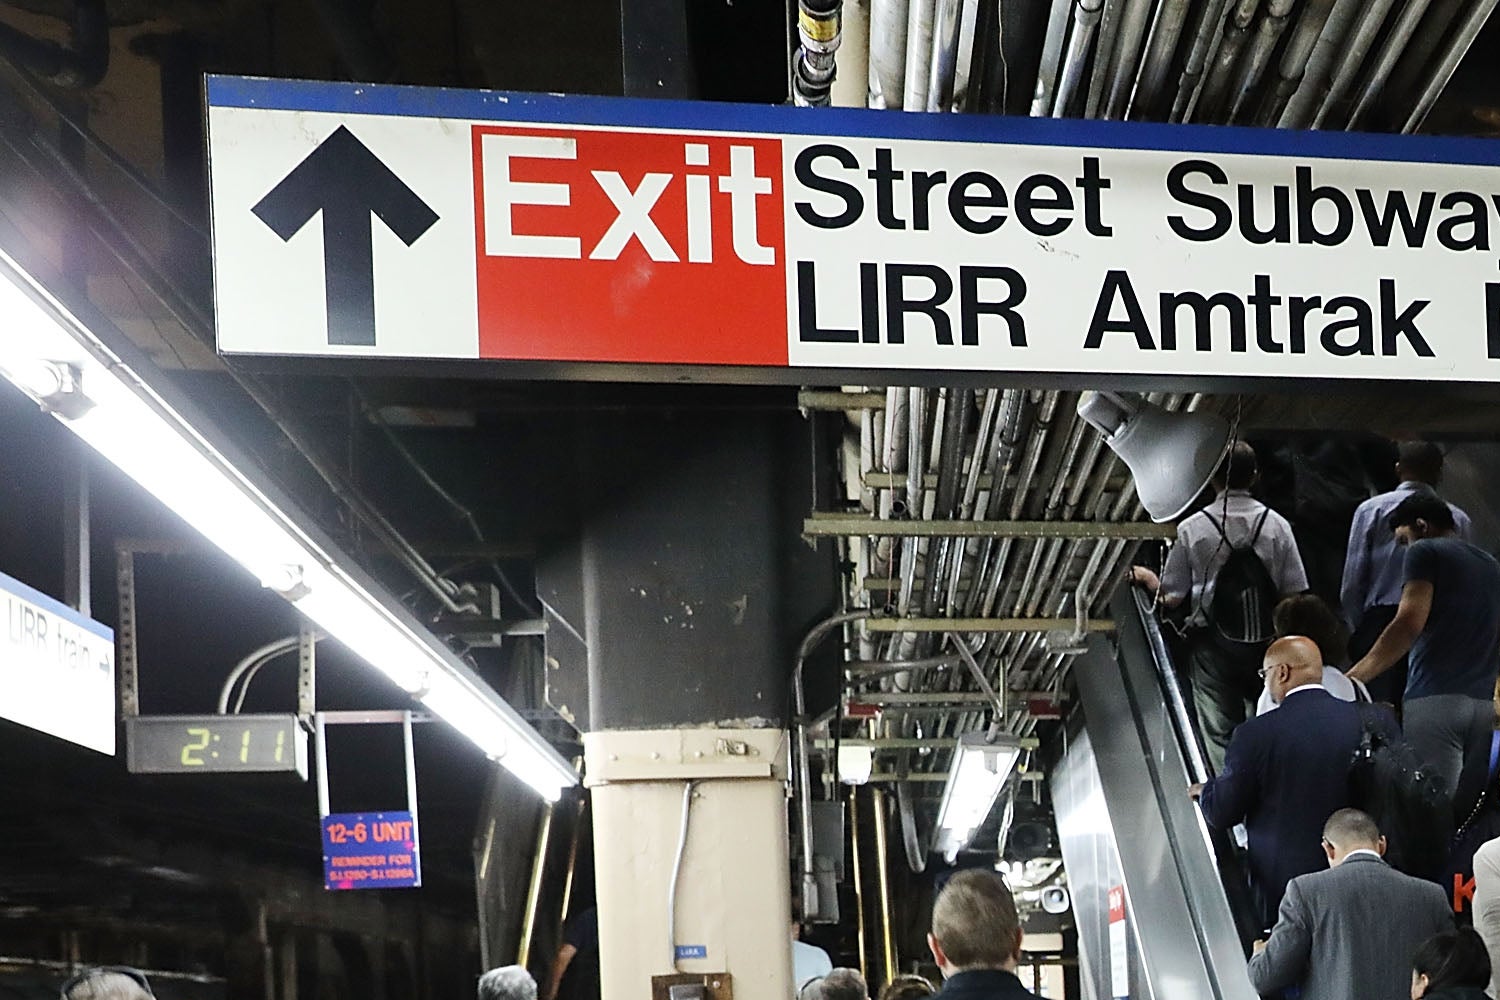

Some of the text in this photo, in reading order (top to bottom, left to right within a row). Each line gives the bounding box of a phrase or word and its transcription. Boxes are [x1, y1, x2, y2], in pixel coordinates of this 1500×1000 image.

[482, 134, 776, 266] Exit
[794, 144, 1113, 237] Street
[796, 260, 1028, 347] LIRR
[1083, 270, 1436, 358] Amtrak
[8, 598, 91, 669] LIRR train
[181, 728, 285, 766] 2:11
[326, 821, 412, 844] 12-6 UNIT
[388, 853, 412, 866] FOR
